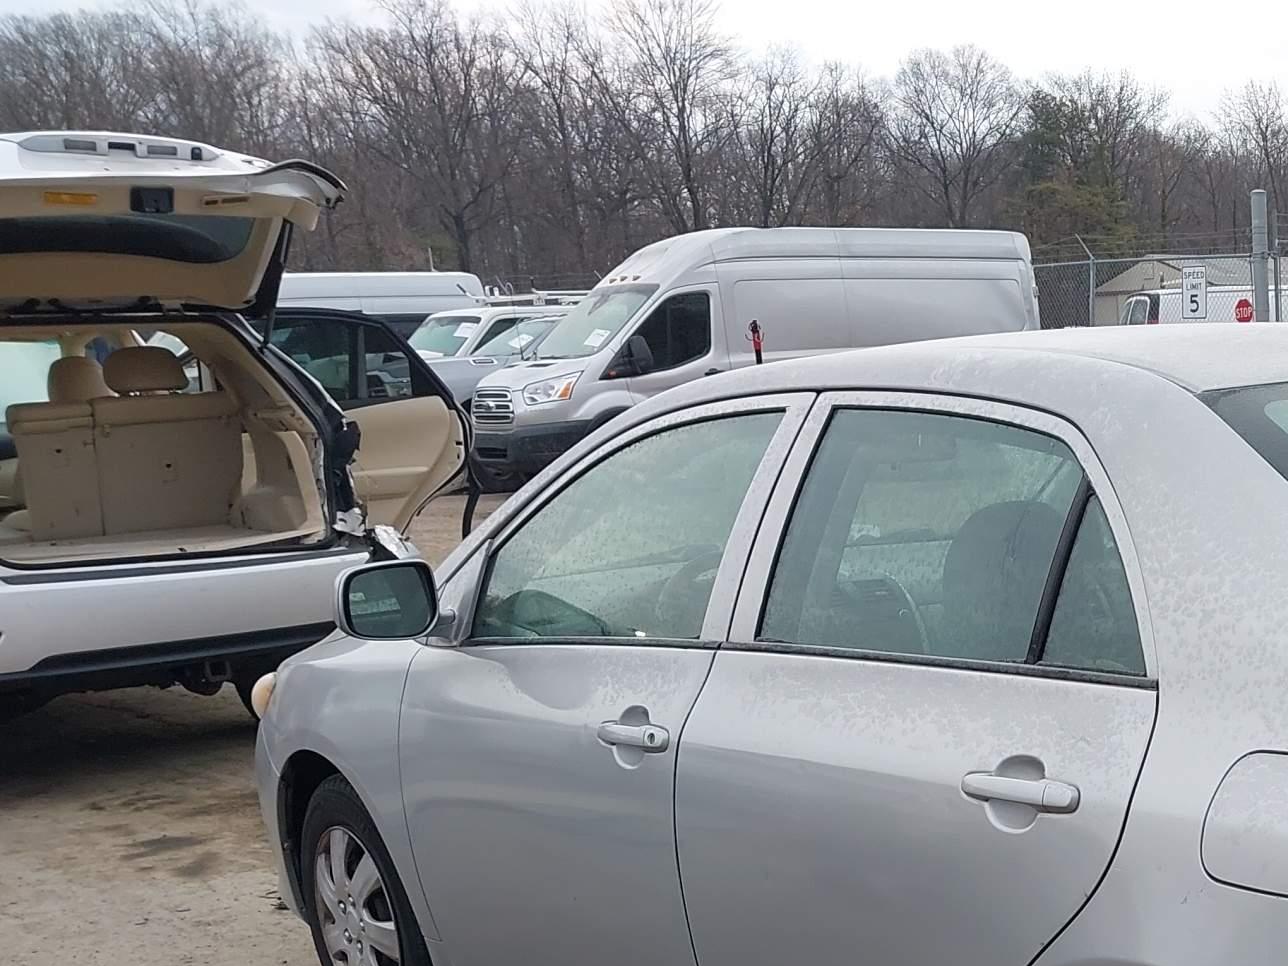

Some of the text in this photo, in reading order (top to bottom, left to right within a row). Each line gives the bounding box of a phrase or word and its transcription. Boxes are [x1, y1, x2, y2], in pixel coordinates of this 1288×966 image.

[1183, 271, 1204, 280] SPEED
[1185, 282, 1202, 291] LIMIT
[1189, 294, 1200, 313] 5
[1235, 306, 1253, 319] STOP
